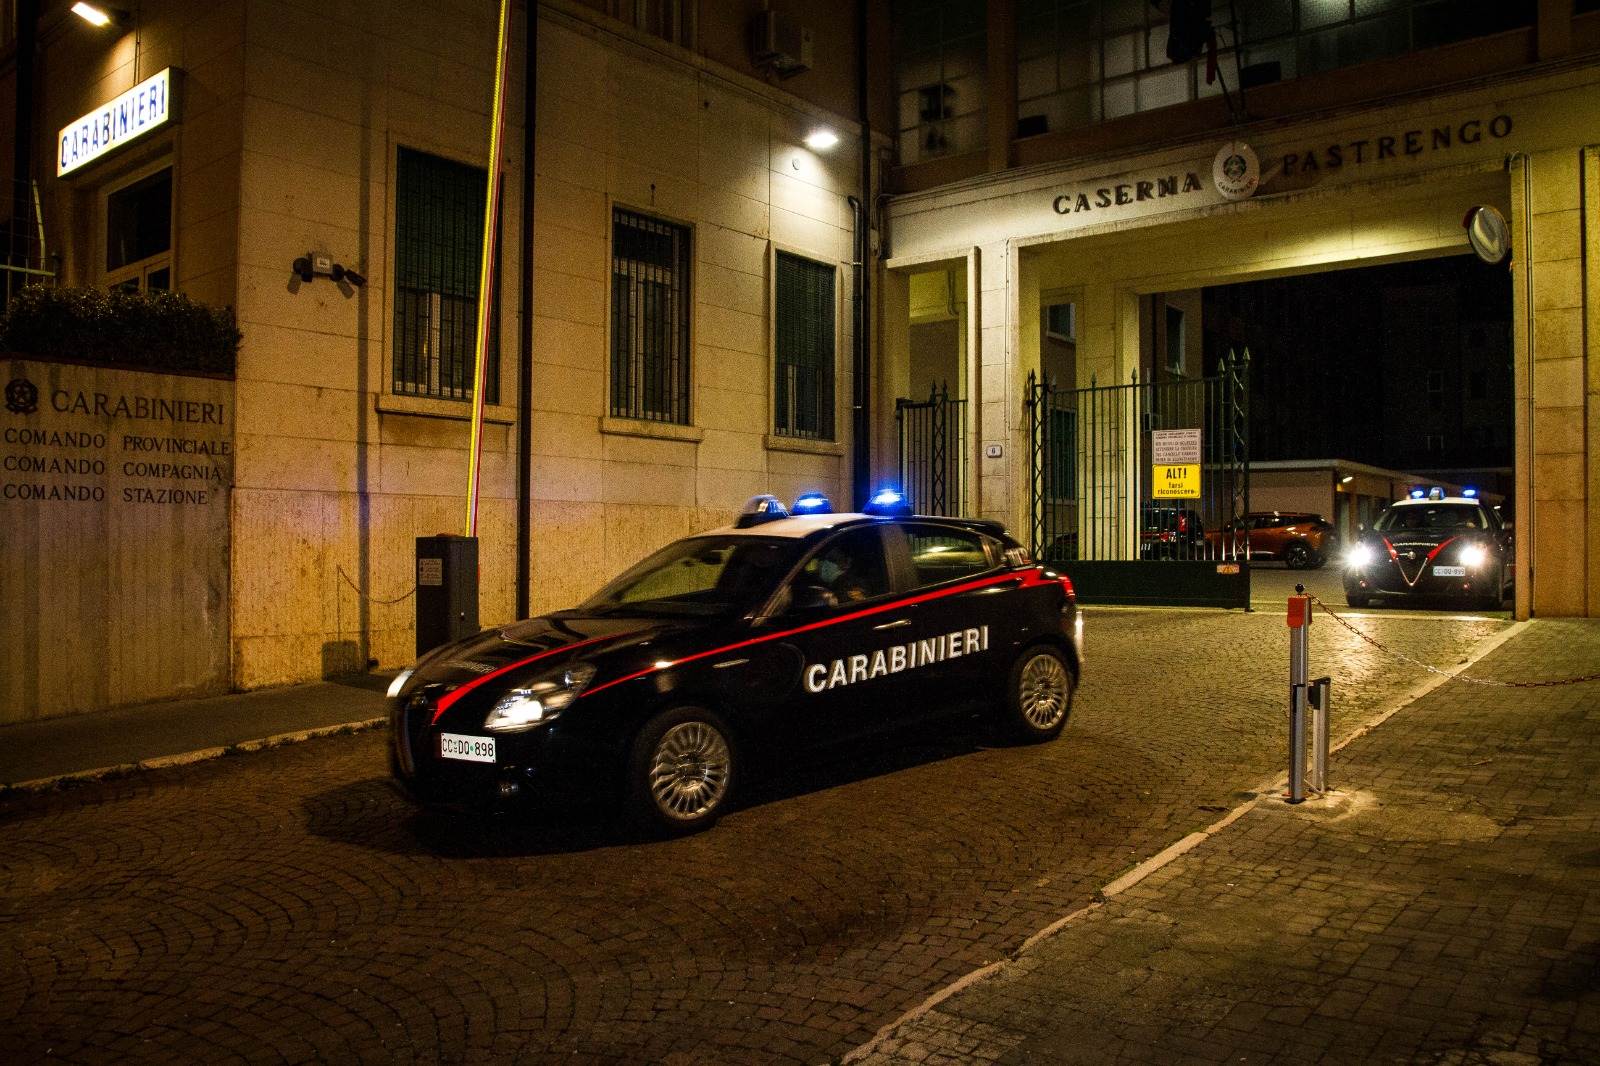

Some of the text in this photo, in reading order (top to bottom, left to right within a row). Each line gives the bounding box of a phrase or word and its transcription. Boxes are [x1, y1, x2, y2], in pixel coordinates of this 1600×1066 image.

[60, 79, 165, 168] CARABINIERI
[1053, 114, 1513, 215] CASERNA PASTRENGO
[51, 389, 225, 425] CARABINIERI
[4, 428, 232, 456] COMANDO PROVINCIALE
[4, 456, 222, 481] COMANDO COMPAGNIA
[1166, 468, 1187, 479] ALT!
[3, 484, 208, 505] COMANDO STAZIONE
[803, 625, 989, 693] CARABINIERI
